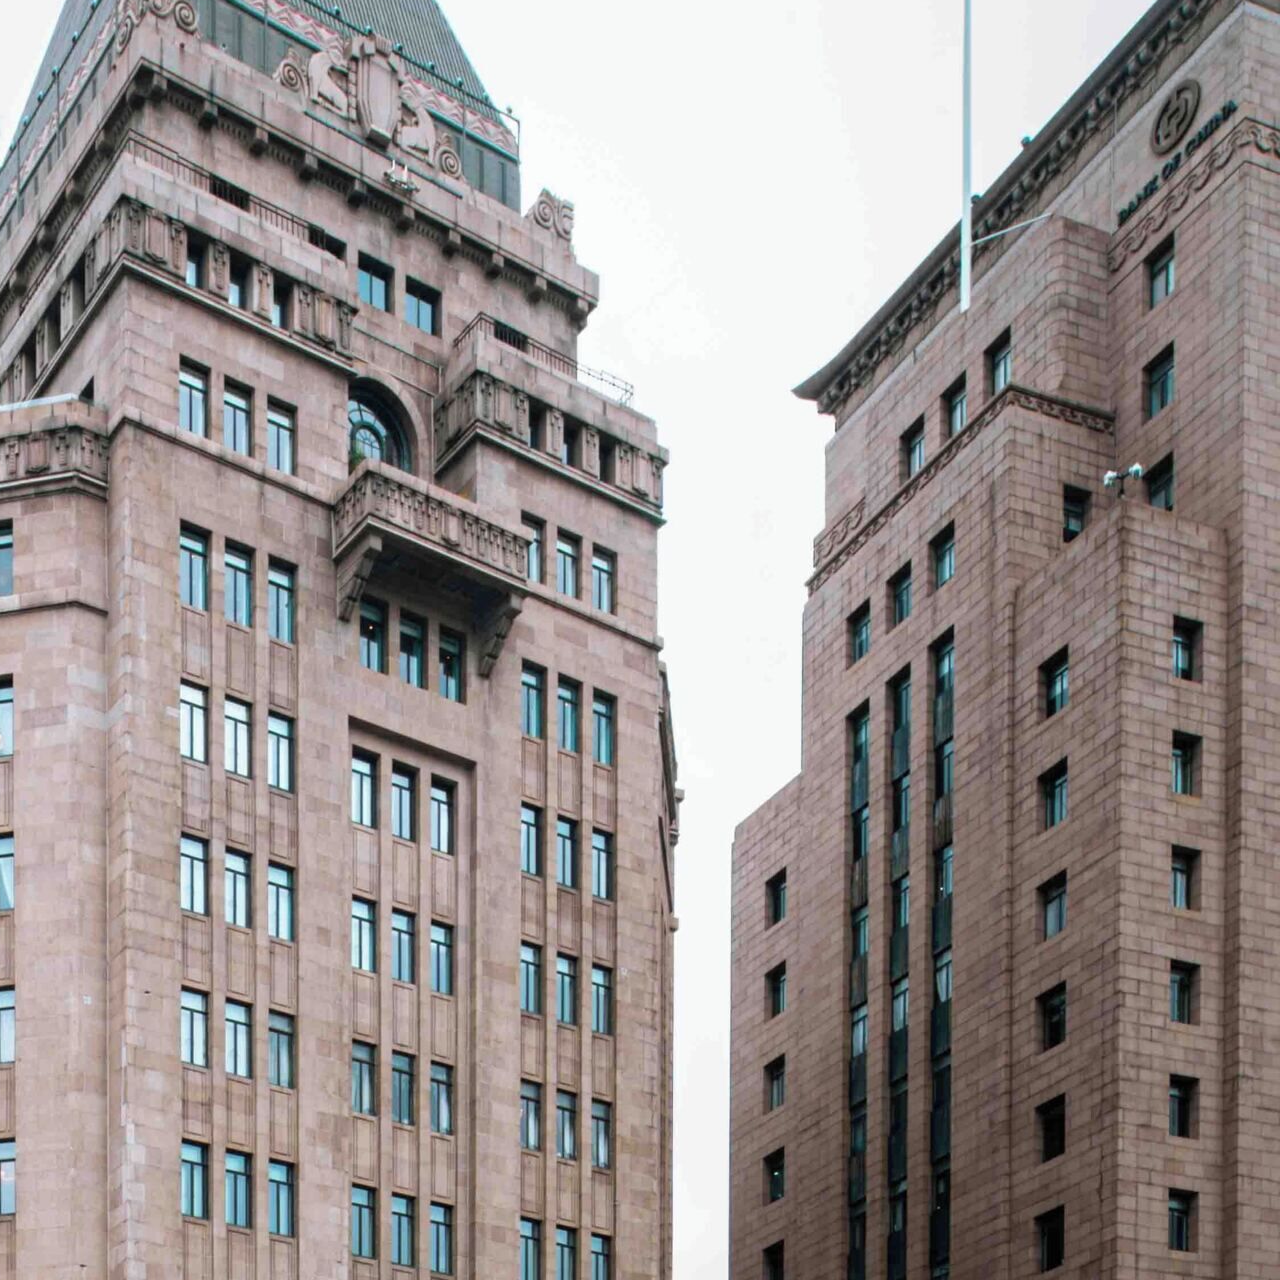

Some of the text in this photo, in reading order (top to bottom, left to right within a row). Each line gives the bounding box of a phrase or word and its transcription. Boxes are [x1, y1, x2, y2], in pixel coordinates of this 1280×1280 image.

[1118, 100, 1238, 227] BANK OF CHINA
